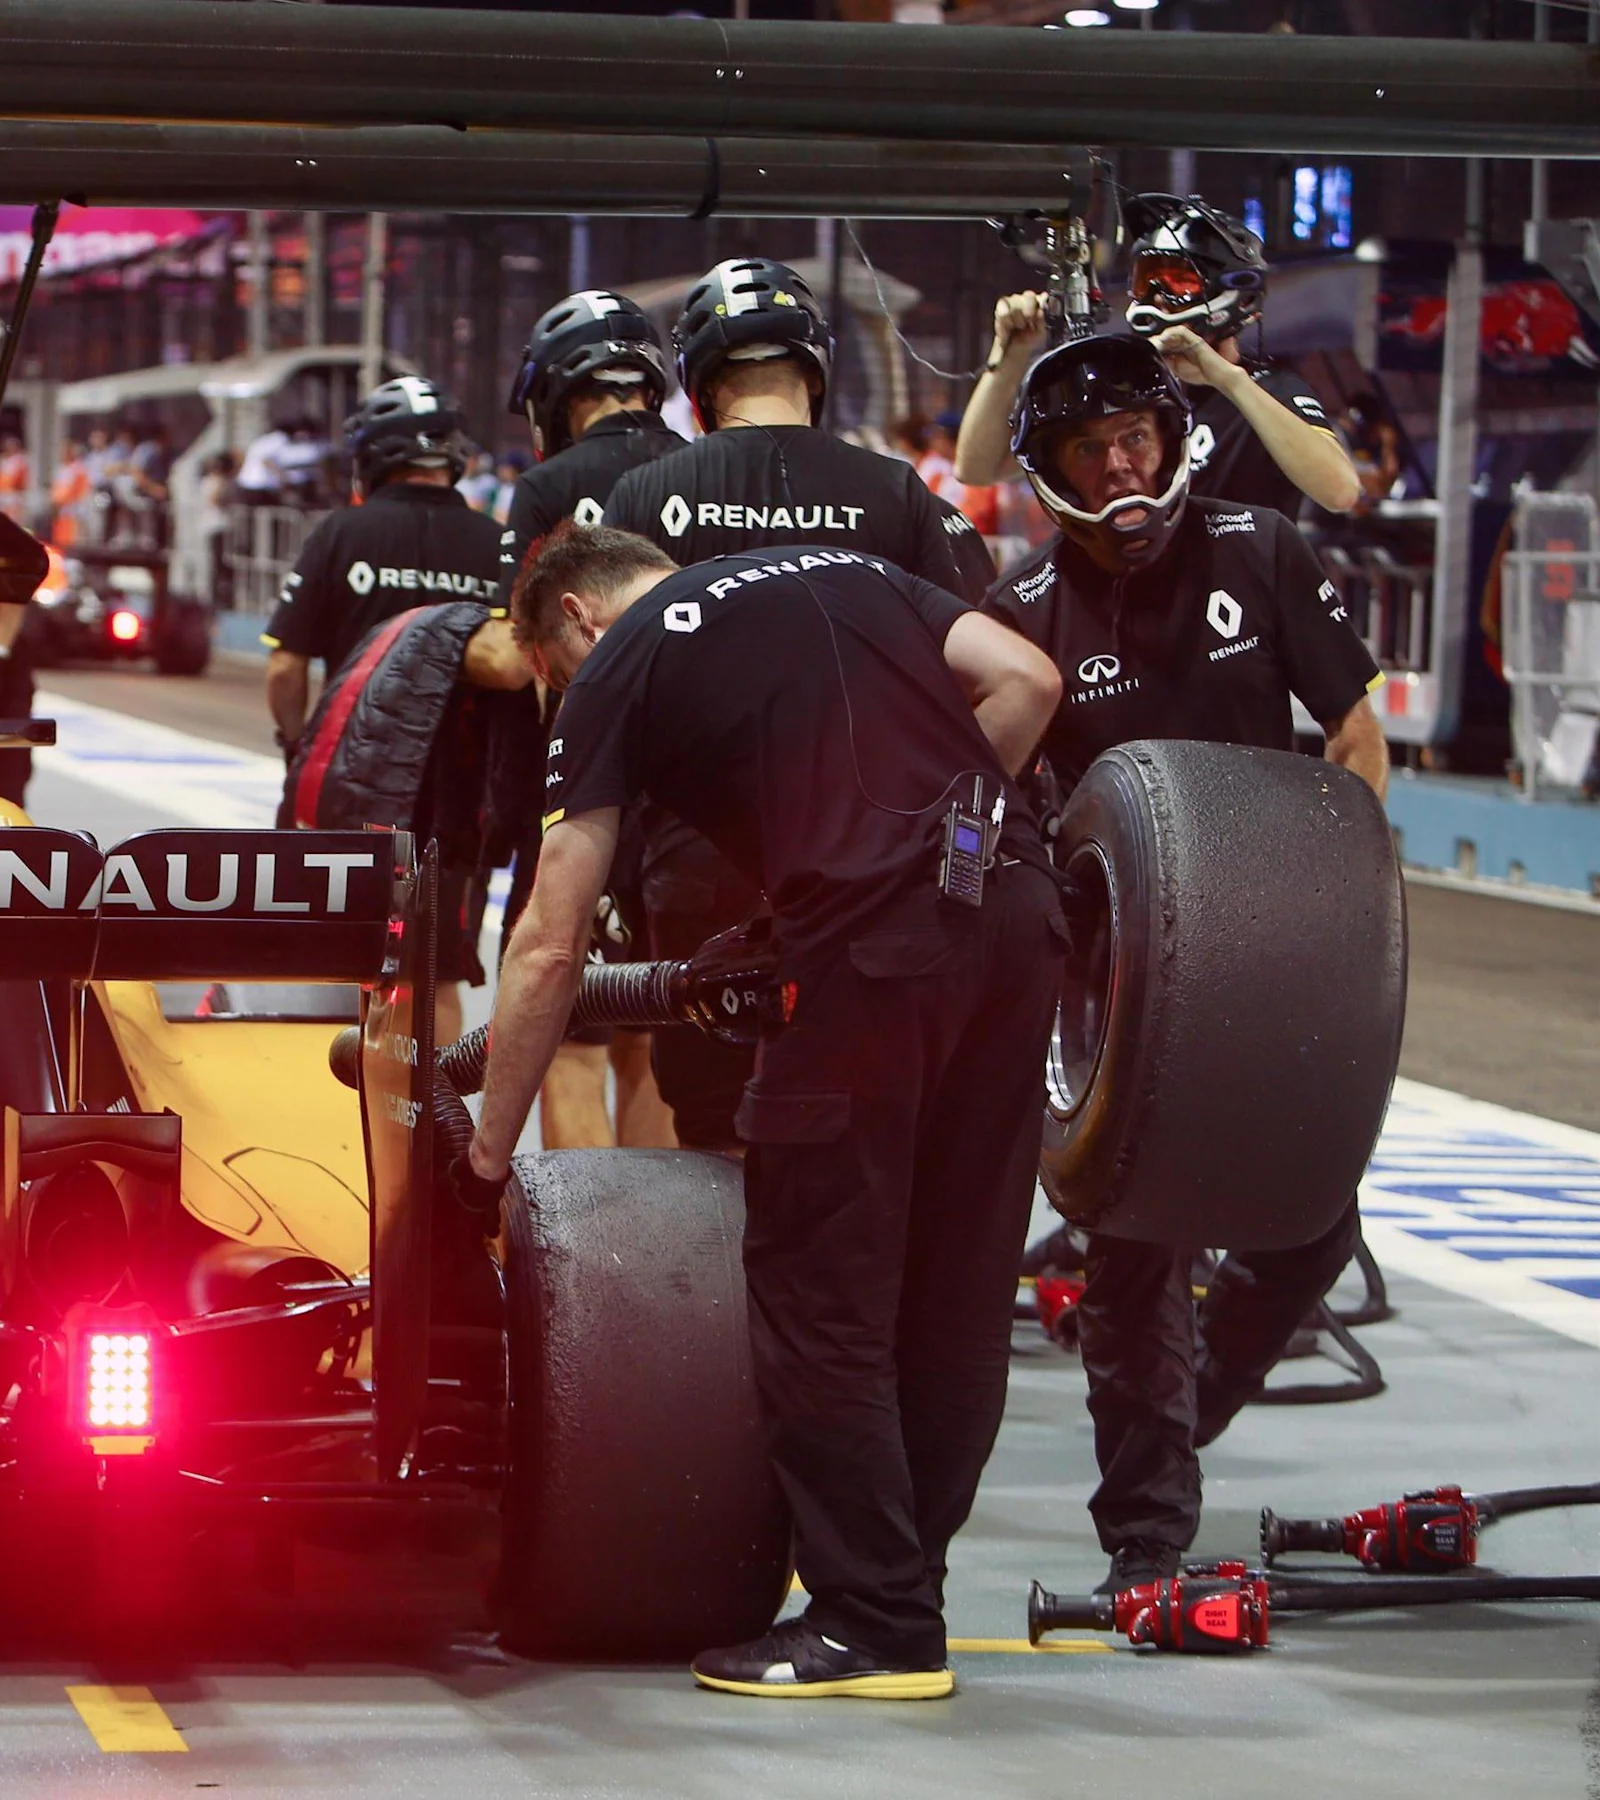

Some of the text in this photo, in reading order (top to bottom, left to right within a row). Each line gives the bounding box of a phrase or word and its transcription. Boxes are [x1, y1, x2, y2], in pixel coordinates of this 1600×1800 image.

[697, 503, 865, 531] RENAULT
[1205, 510, 1253, 524] Microsoft
[1207, 522, 1256, 538] Dynamics
[379, 567, 499, 598] RENAULT
[706, 551, 888, 600] RENAULT
[1012, 562, 1055, 594] Microsoft
[1208, 636, 1260, 662] RENAULT
[1071, 678, 1140, 704] INFINITI
